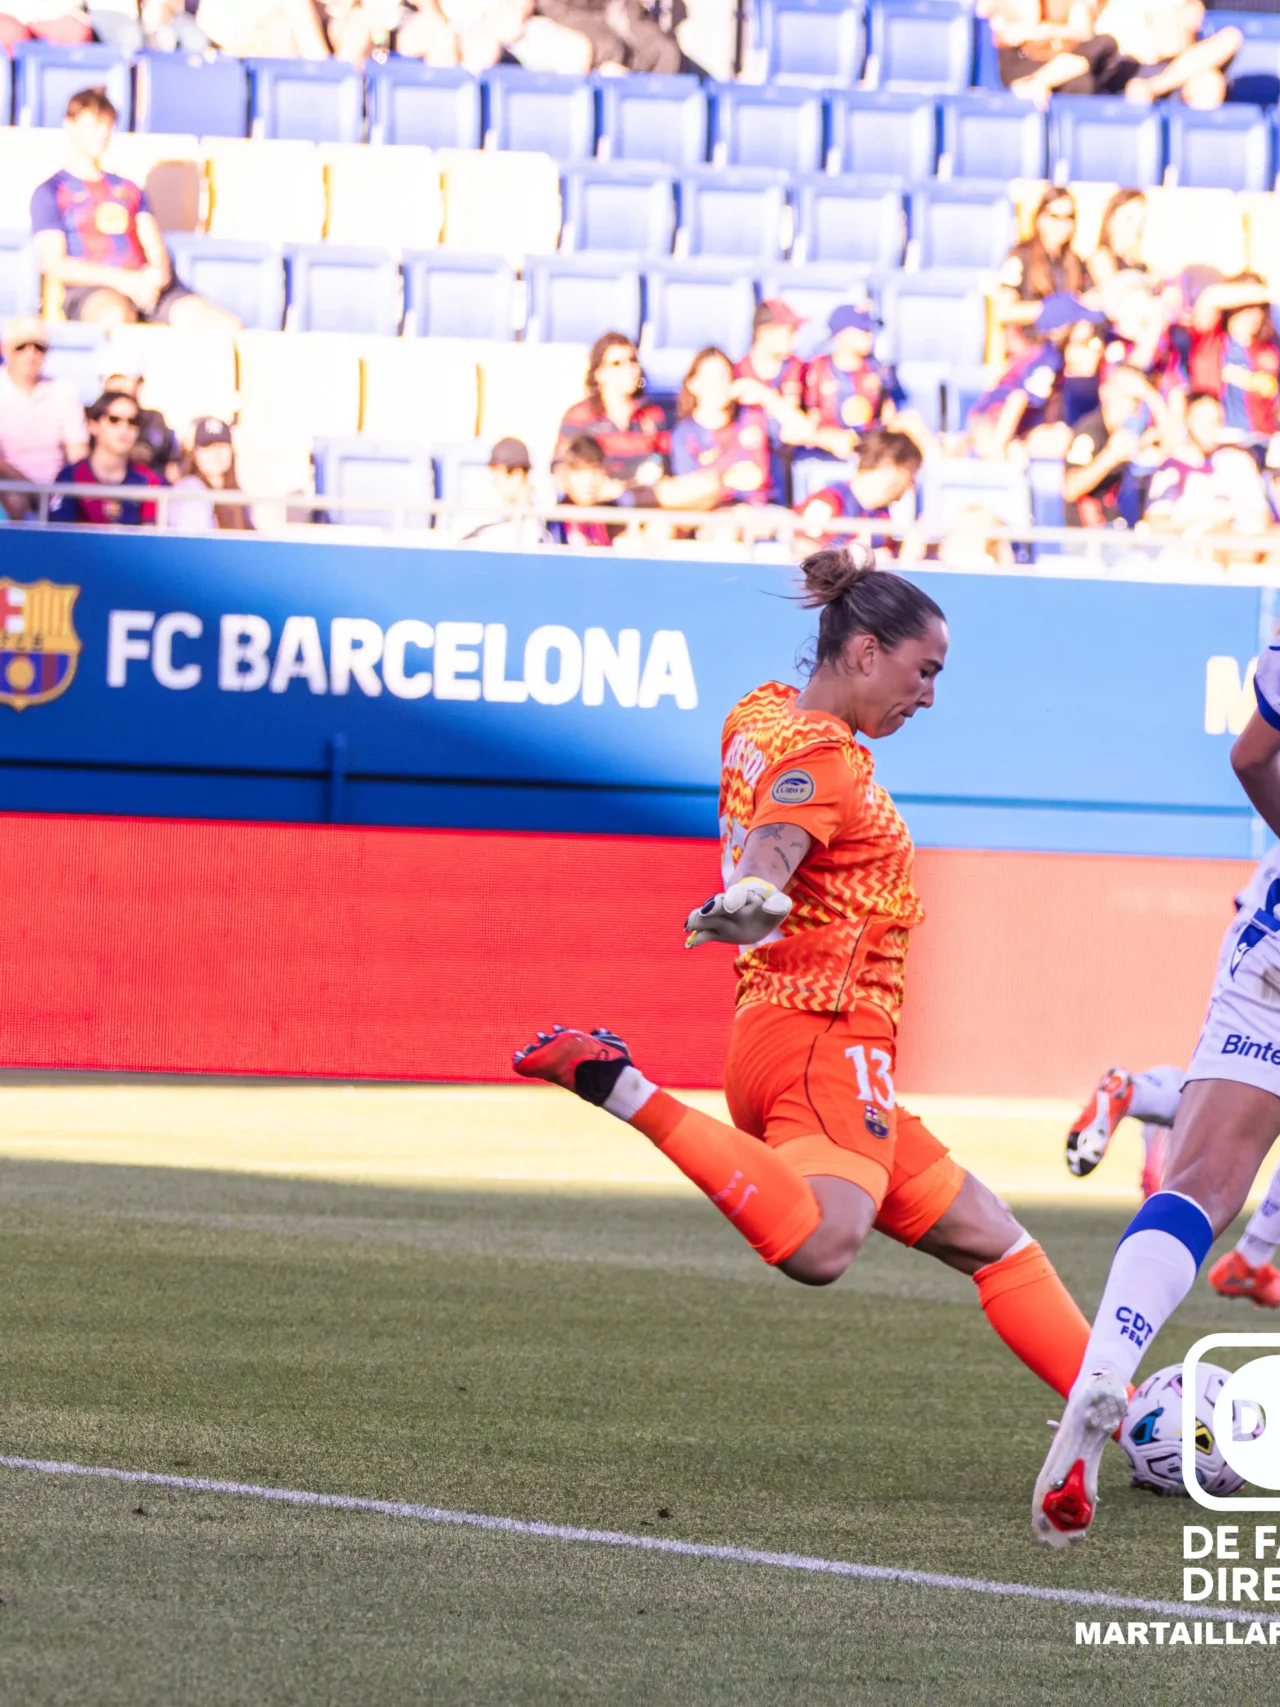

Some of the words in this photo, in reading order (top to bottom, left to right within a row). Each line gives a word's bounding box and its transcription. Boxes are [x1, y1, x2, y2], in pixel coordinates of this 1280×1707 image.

[108, 610, 202, 690] FC
[219, 614, 699, 710] BARCELONA
[844, 1045, 895, 1111] 13
[1116, 1306, 1153, 1340] CDT
[1121, 1325, 1144, 1349] FEM
